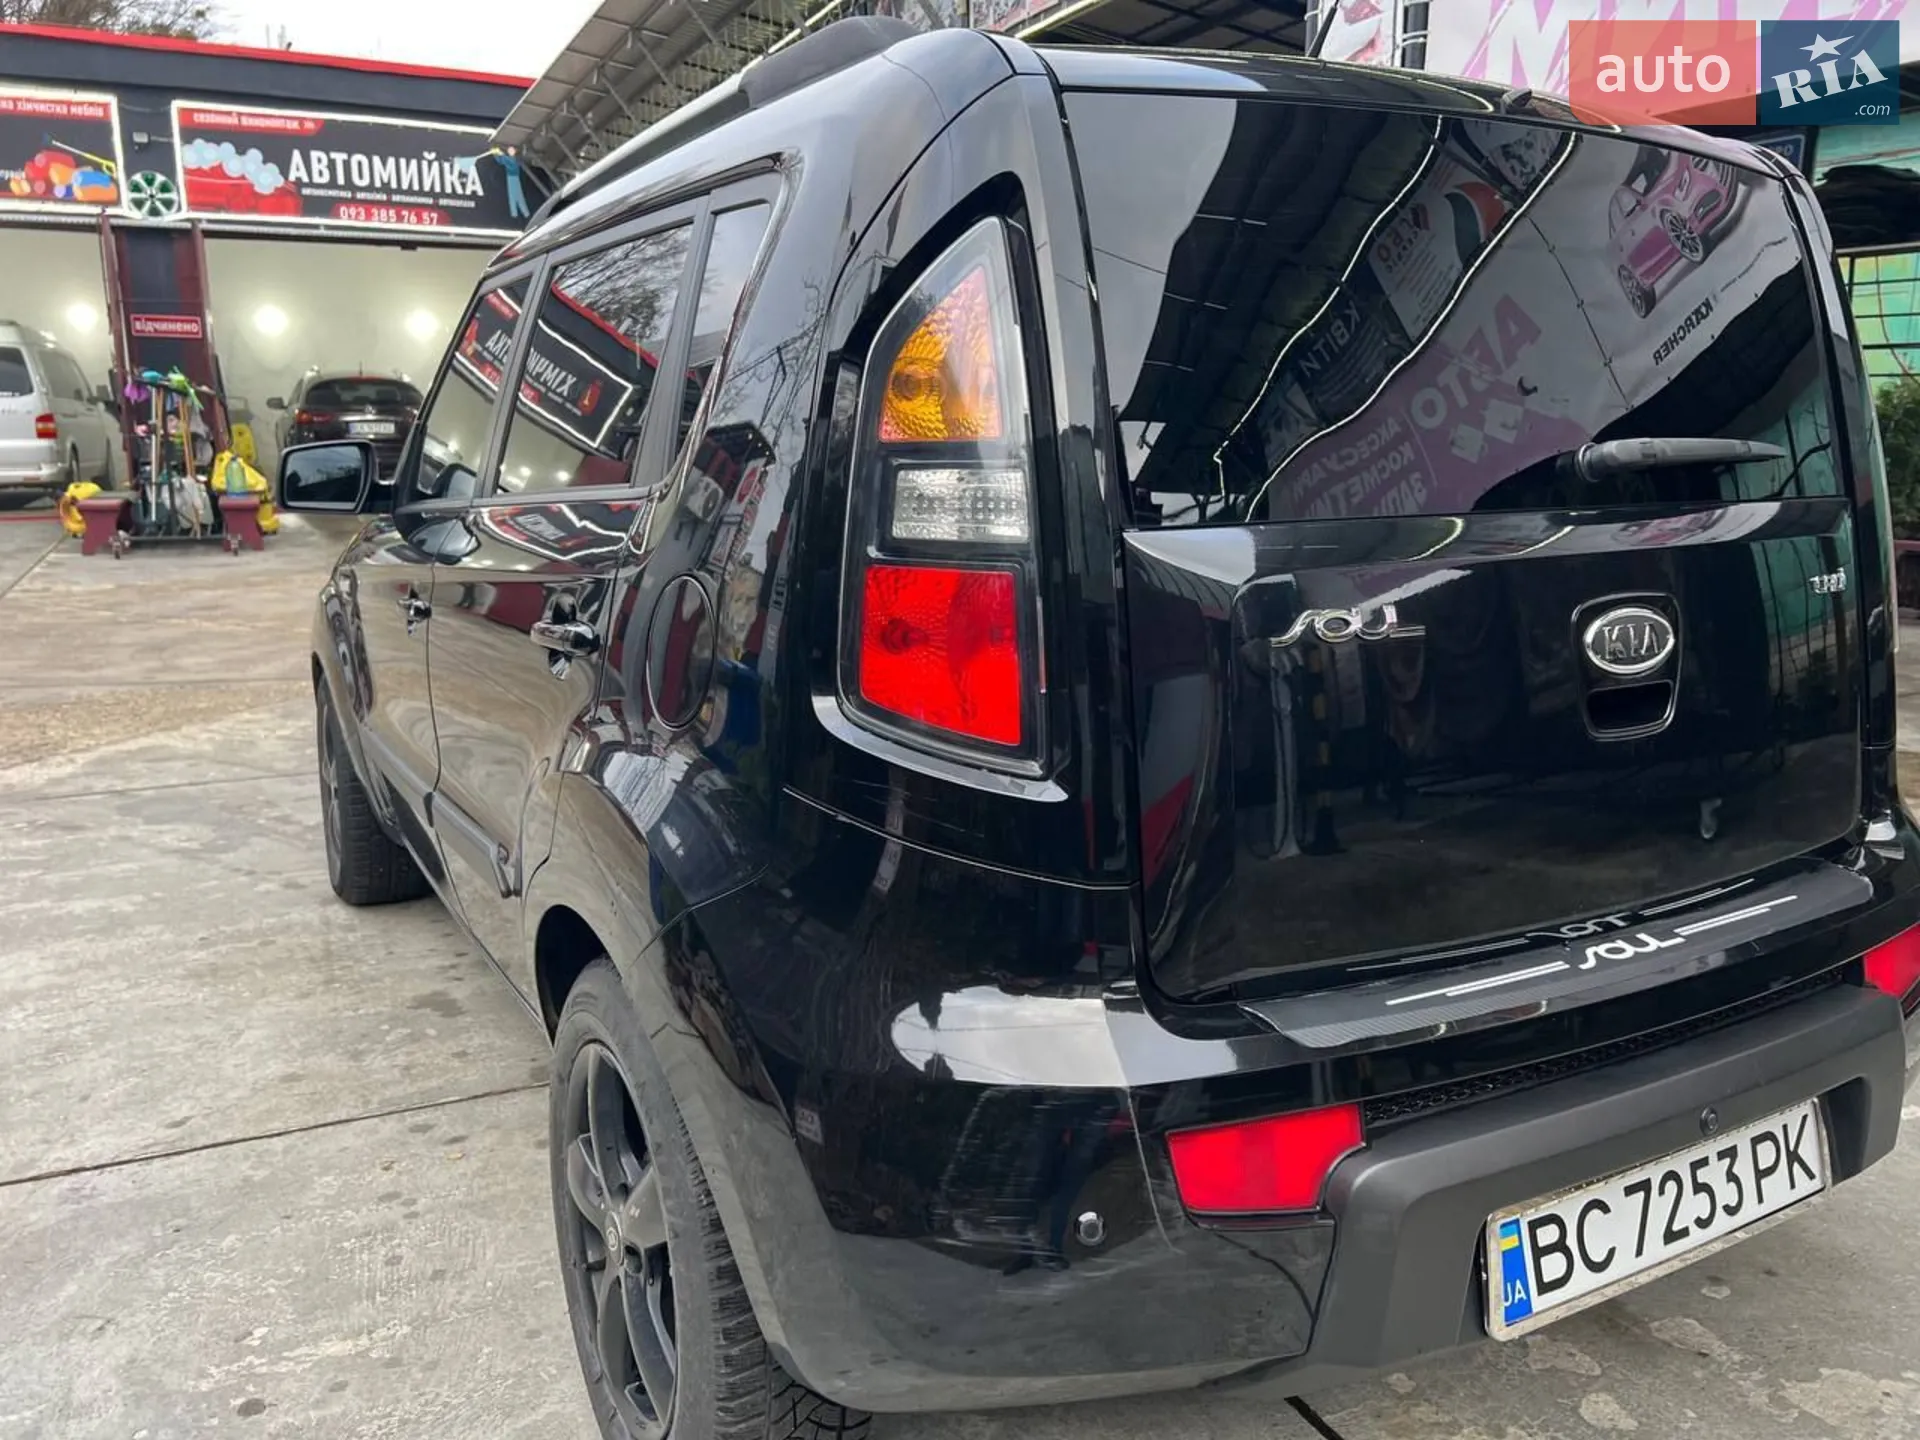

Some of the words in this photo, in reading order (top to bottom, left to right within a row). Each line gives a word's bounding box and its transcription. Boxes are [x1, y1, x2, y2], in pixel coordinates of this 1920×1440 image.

[288, 149, 485, 197] АВТОМИЙКА
[339, 206, 365, 220] 093
[371, 208, 397, 222] 385
[135, 318, 199, 333] відчинено
[1602, 621, 1660, 660] KIA
[1527, 1198, 1618, 1297] BC
[1623, 1144, 1744, 1259] 7253
[1749, 1113, 1817, 1204] PK
